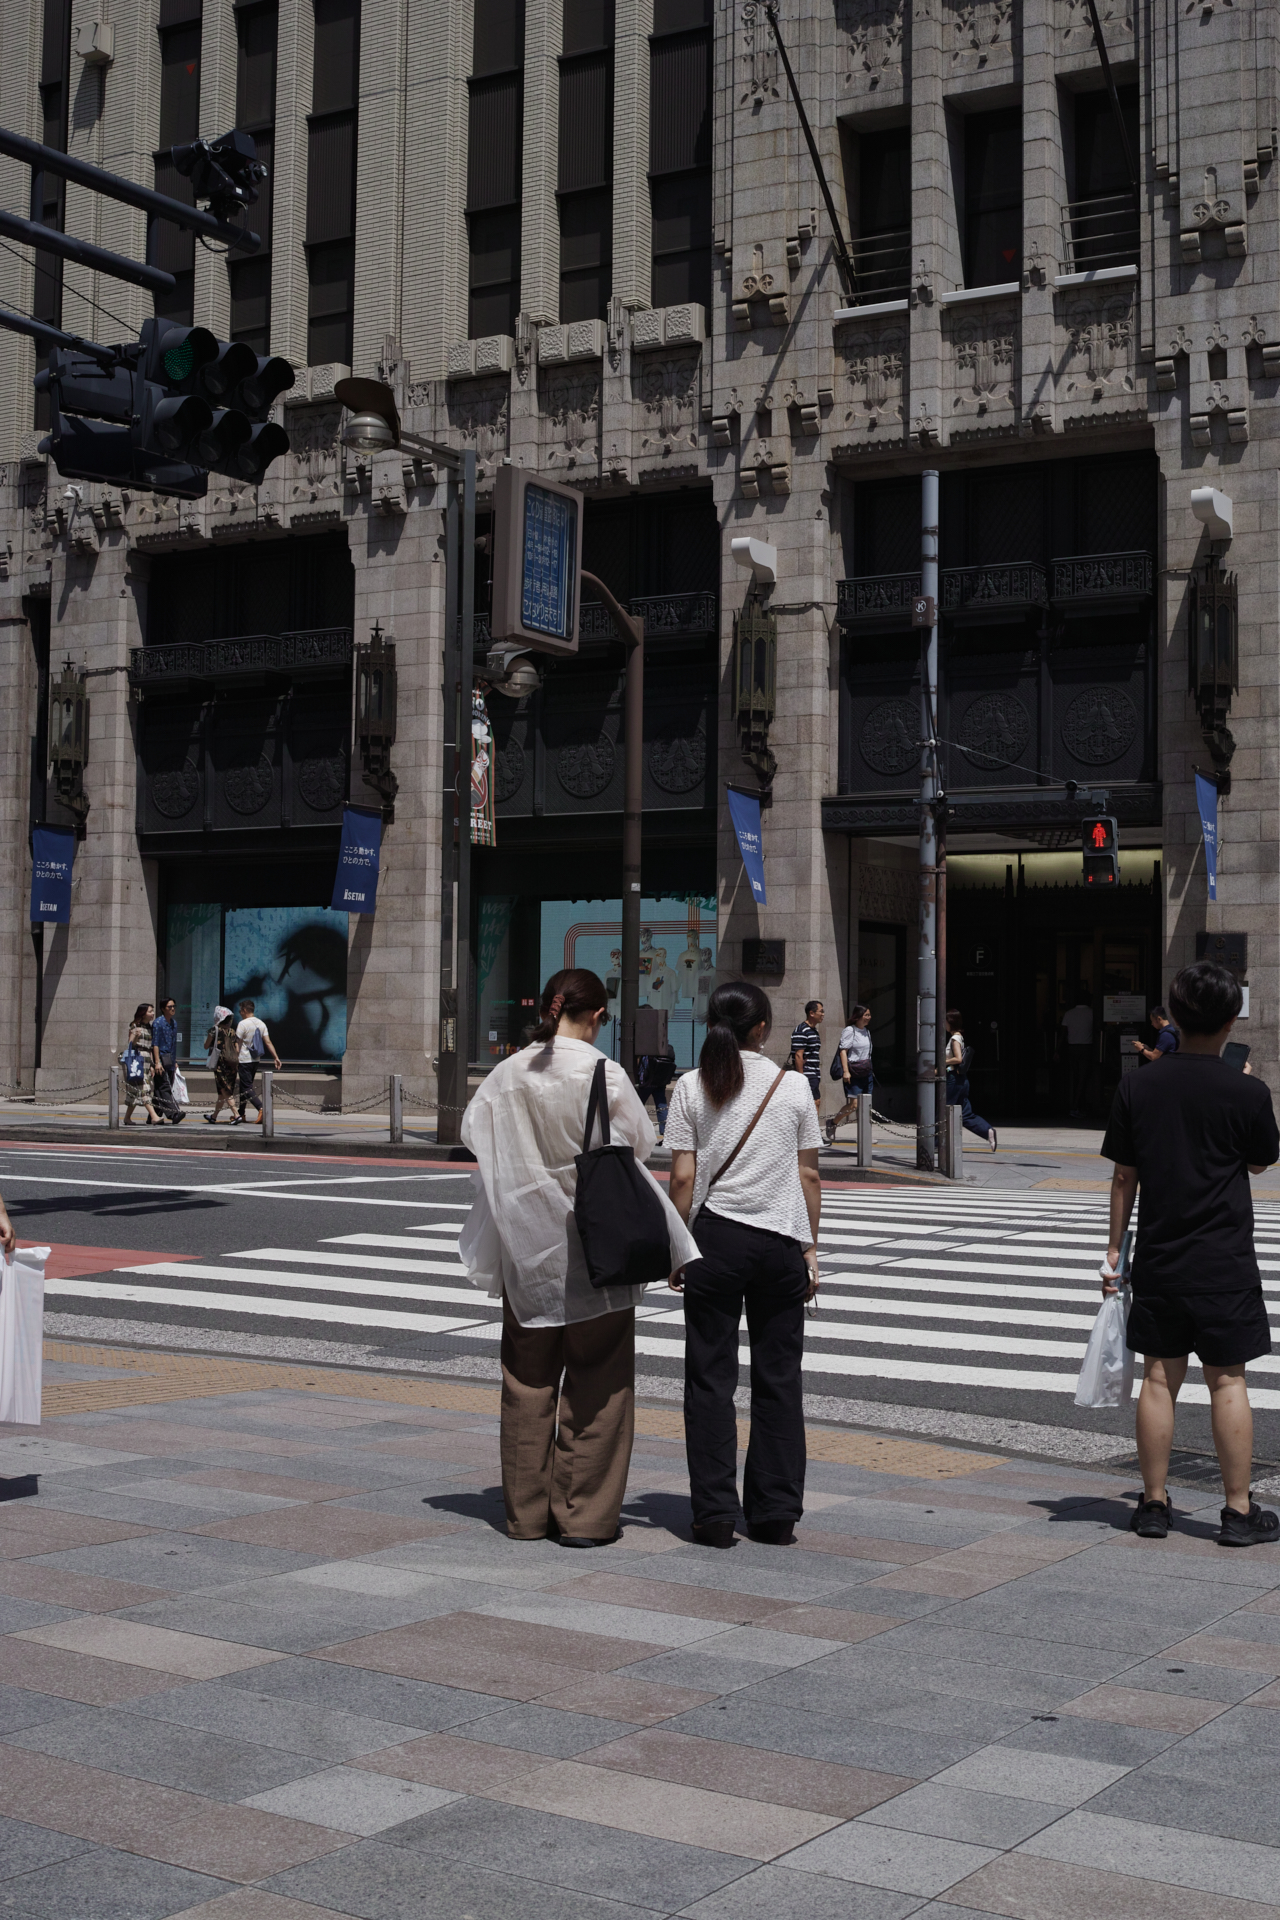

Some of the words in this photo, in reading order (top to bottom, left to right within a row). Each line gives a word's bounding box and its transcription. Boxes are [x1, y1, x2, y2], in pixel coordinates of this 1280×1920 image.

[343, 845, 376, 857] こころ動かす、
[35, 861, 68, 871] こころ動かす、
[342, 856, 371, 867] ひとの力で。
[35, 870, 63, 880] ひとの力で。
